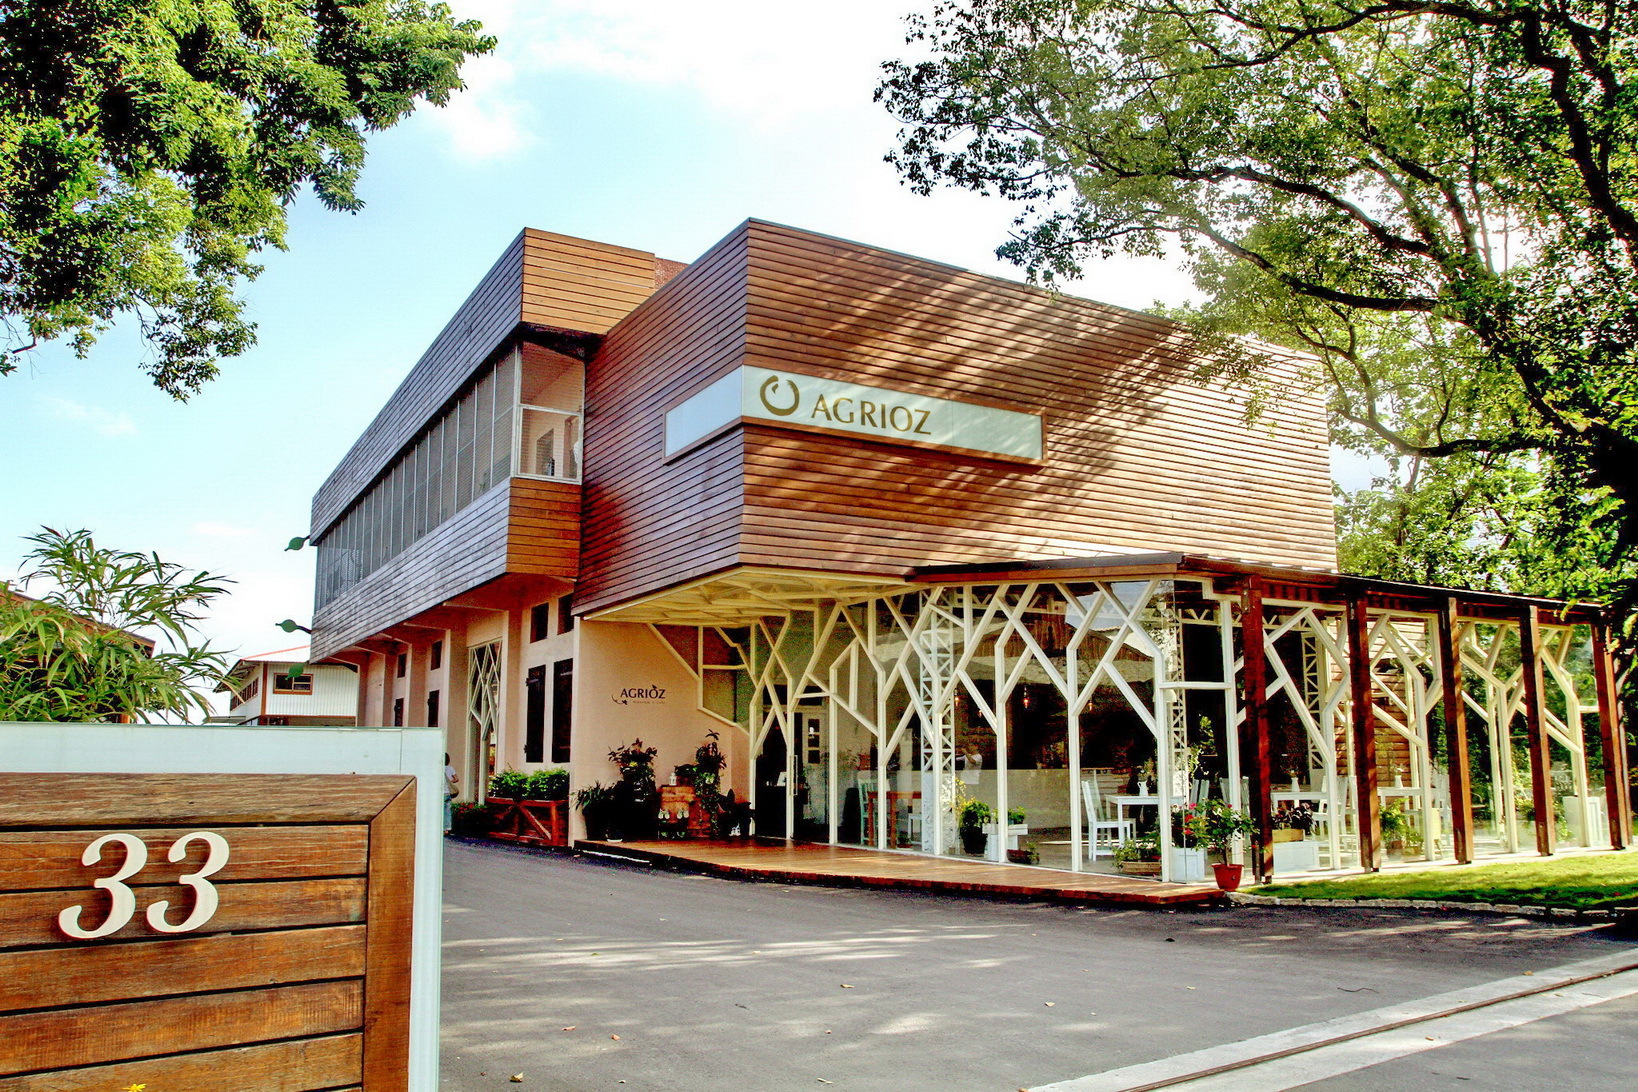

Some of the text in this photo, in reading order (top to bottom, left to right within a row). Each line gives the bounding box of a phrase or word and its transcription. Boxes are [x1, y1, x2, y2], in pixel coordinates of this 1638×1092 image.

[811, 394, 932, 435] AGRIOZ
[620, 686, 666, 699] AGRIOZ
[58, 831, 230, 939] 33
